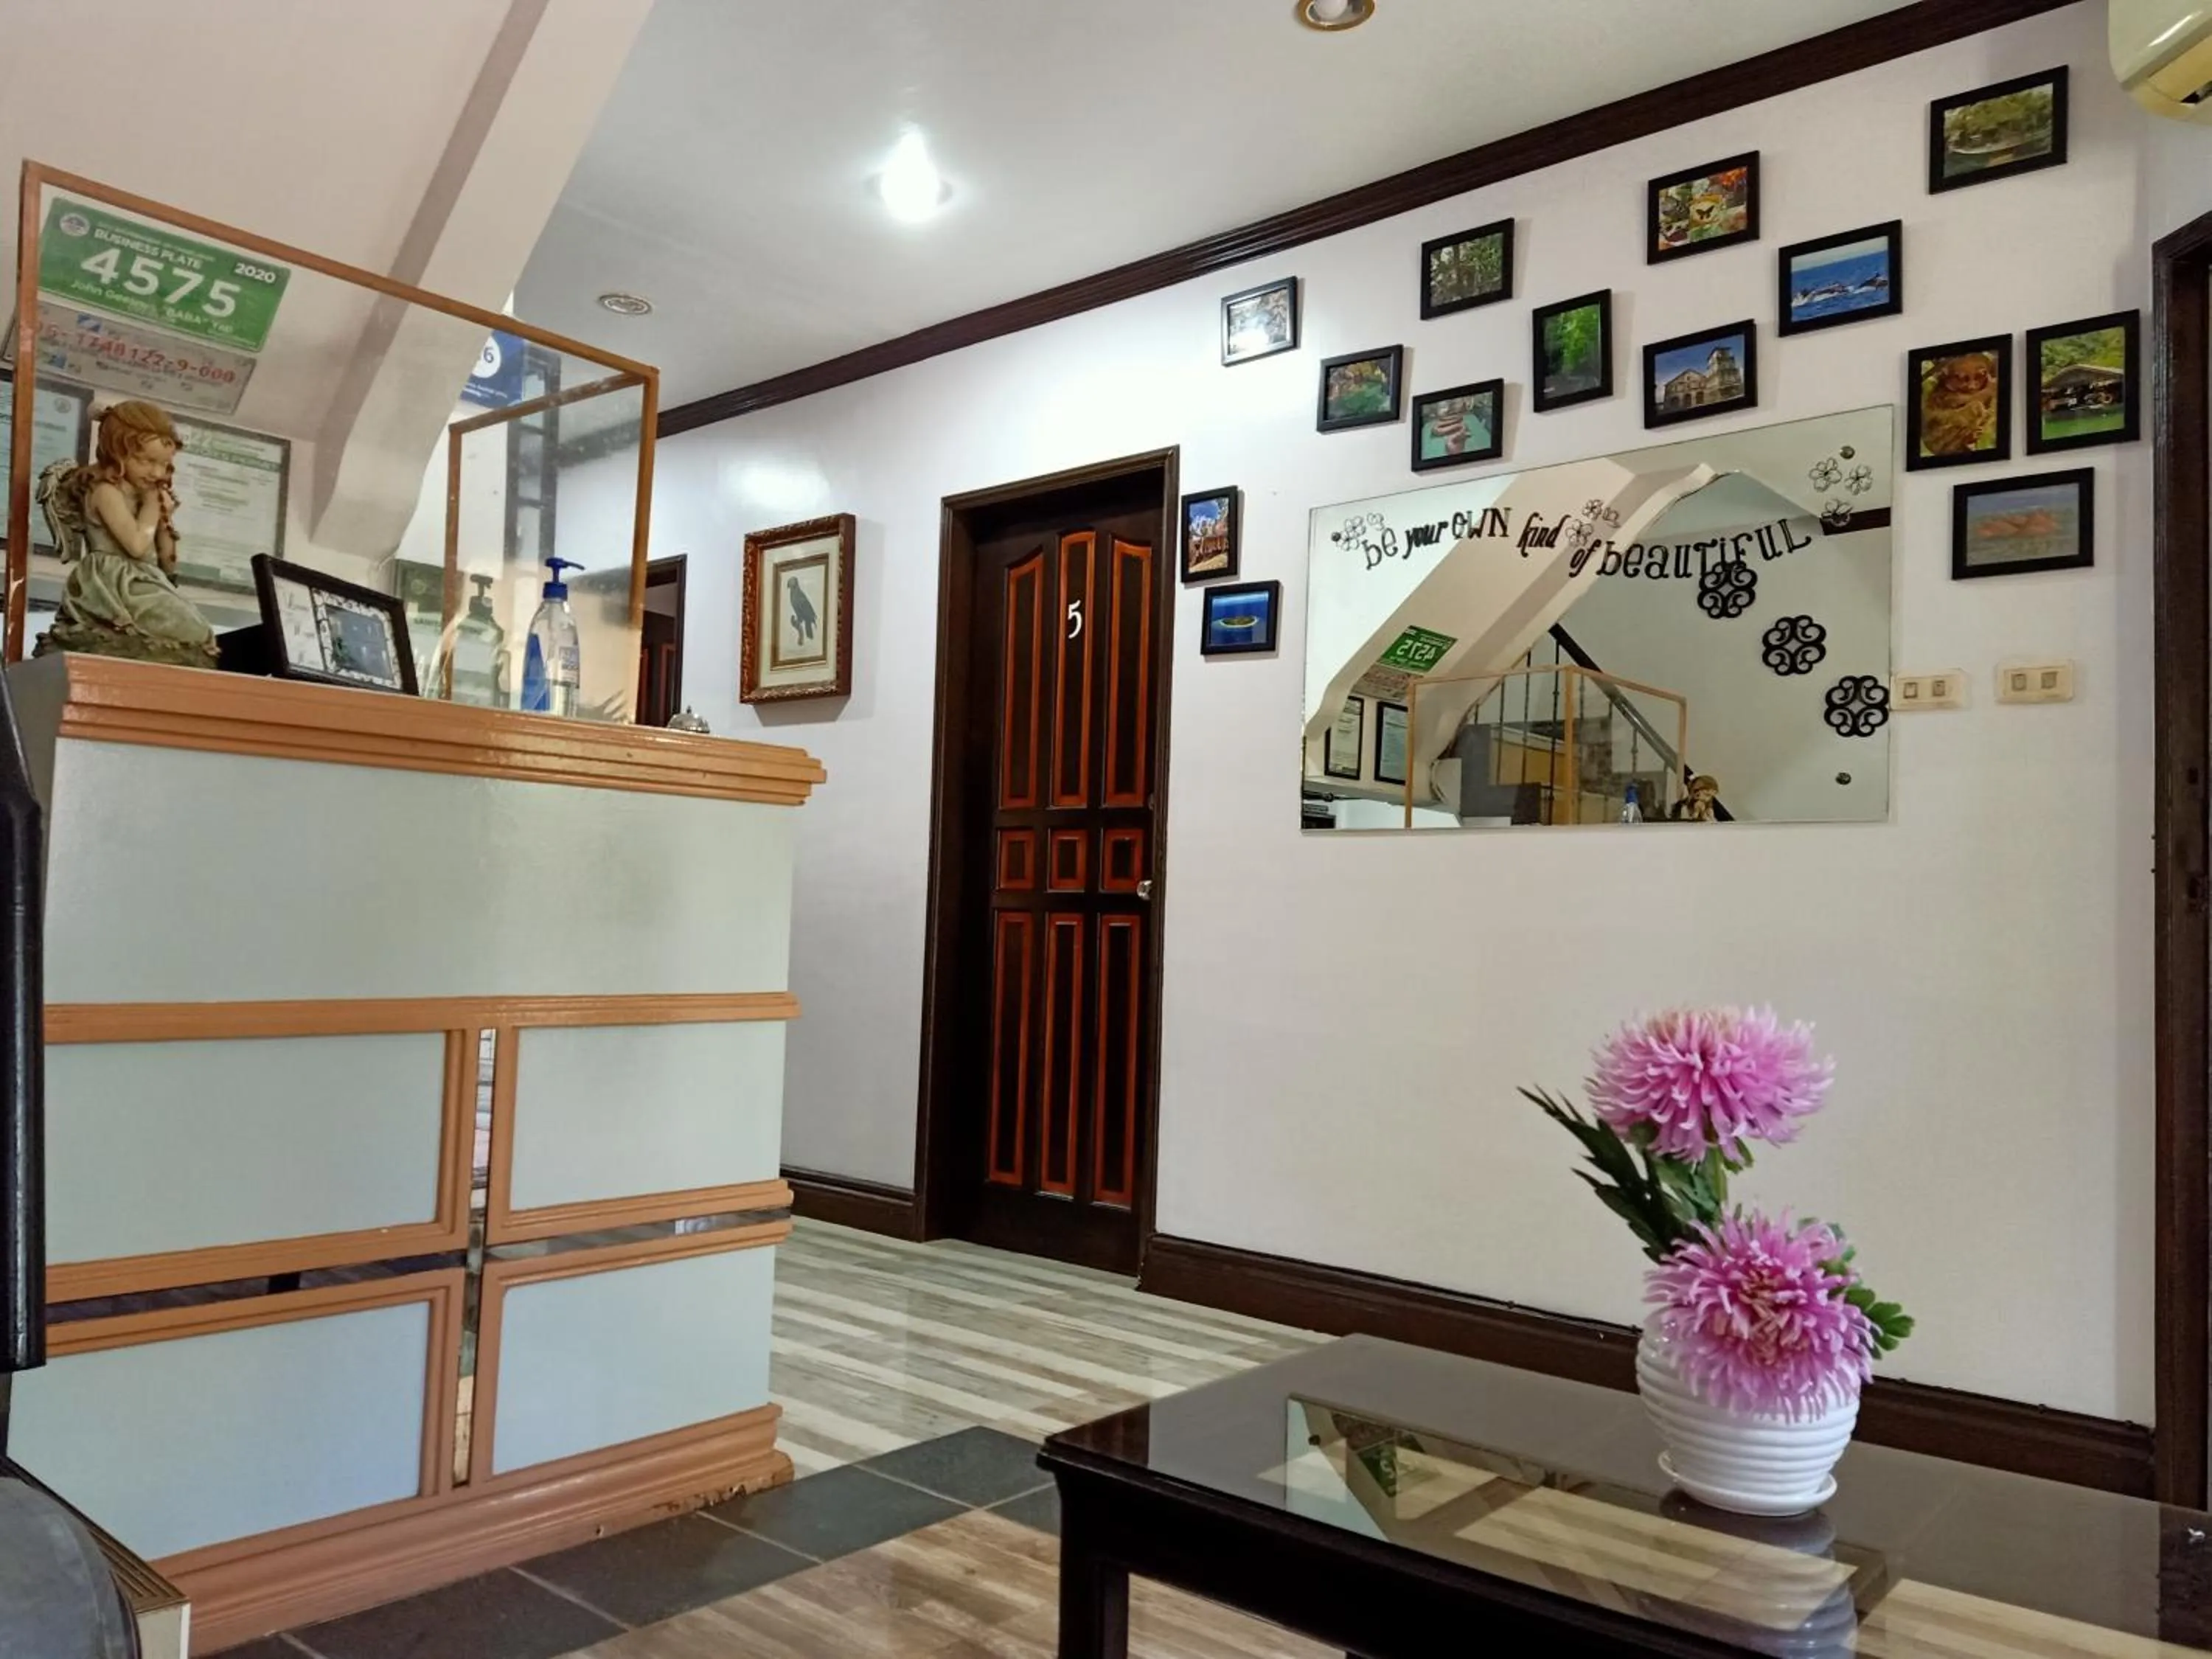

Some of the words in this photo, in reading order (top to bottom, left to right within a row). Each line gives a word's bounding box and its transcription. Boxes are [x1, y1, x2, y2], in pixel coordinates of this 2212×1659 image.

[94, 228, 160, 257] BUSINESS
[161, 248, 204, 270] PLATE
[80, 248, 242, 318] 4575
[234, 262, 276, 284] 2020
[1361, 527, 1399, 570] be
[1402, 521, 1449, 560] your
[1516, 512, 1572, 557] kind
[1568, 539, 1601, 577] of
[1067, 599, 1082, 639] 5
